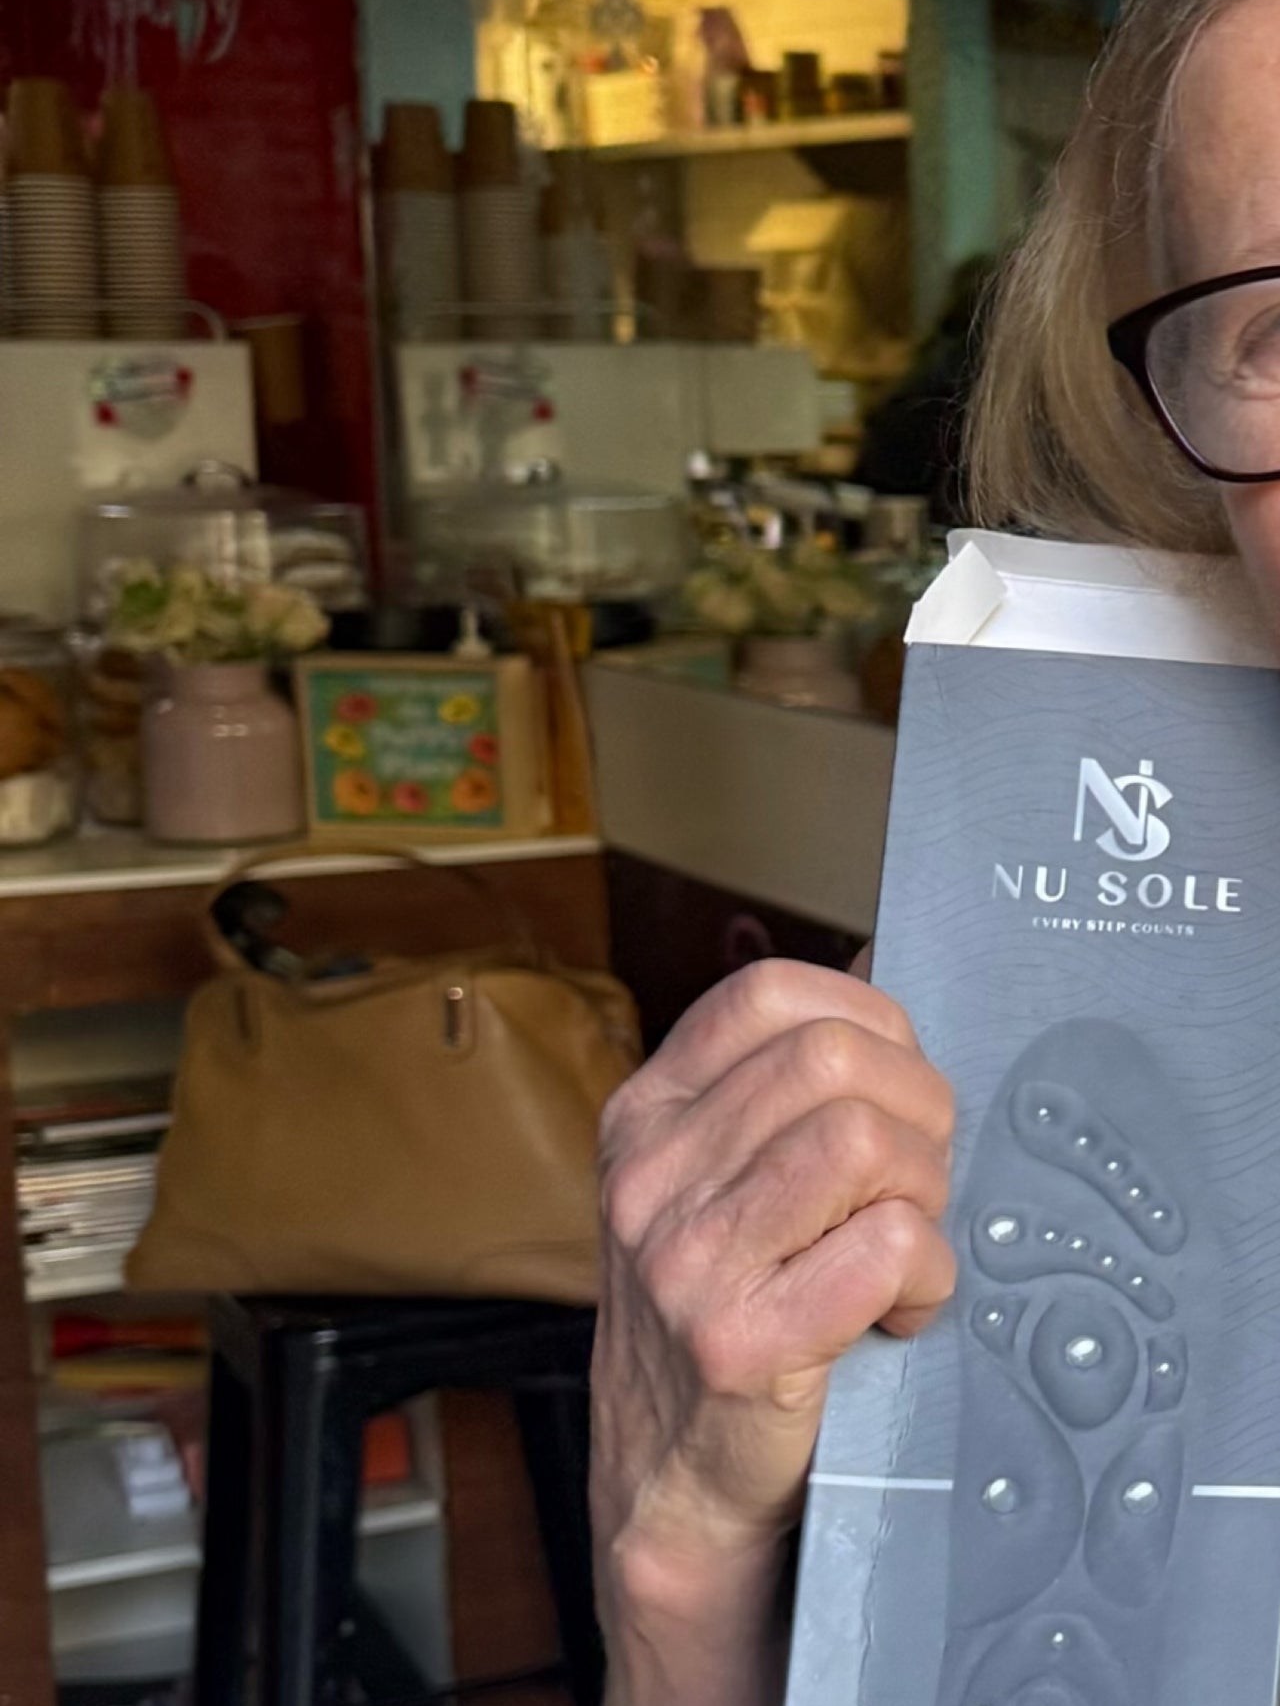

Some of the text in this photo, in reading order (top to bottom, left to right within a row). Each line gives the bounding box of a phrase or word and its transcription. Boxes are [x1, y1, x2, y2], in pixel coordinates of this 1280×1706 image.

[992, 863, 1243, 912] NU SOLE
[1032, 917, 1195, 936] EVERY STEP COUNTS
